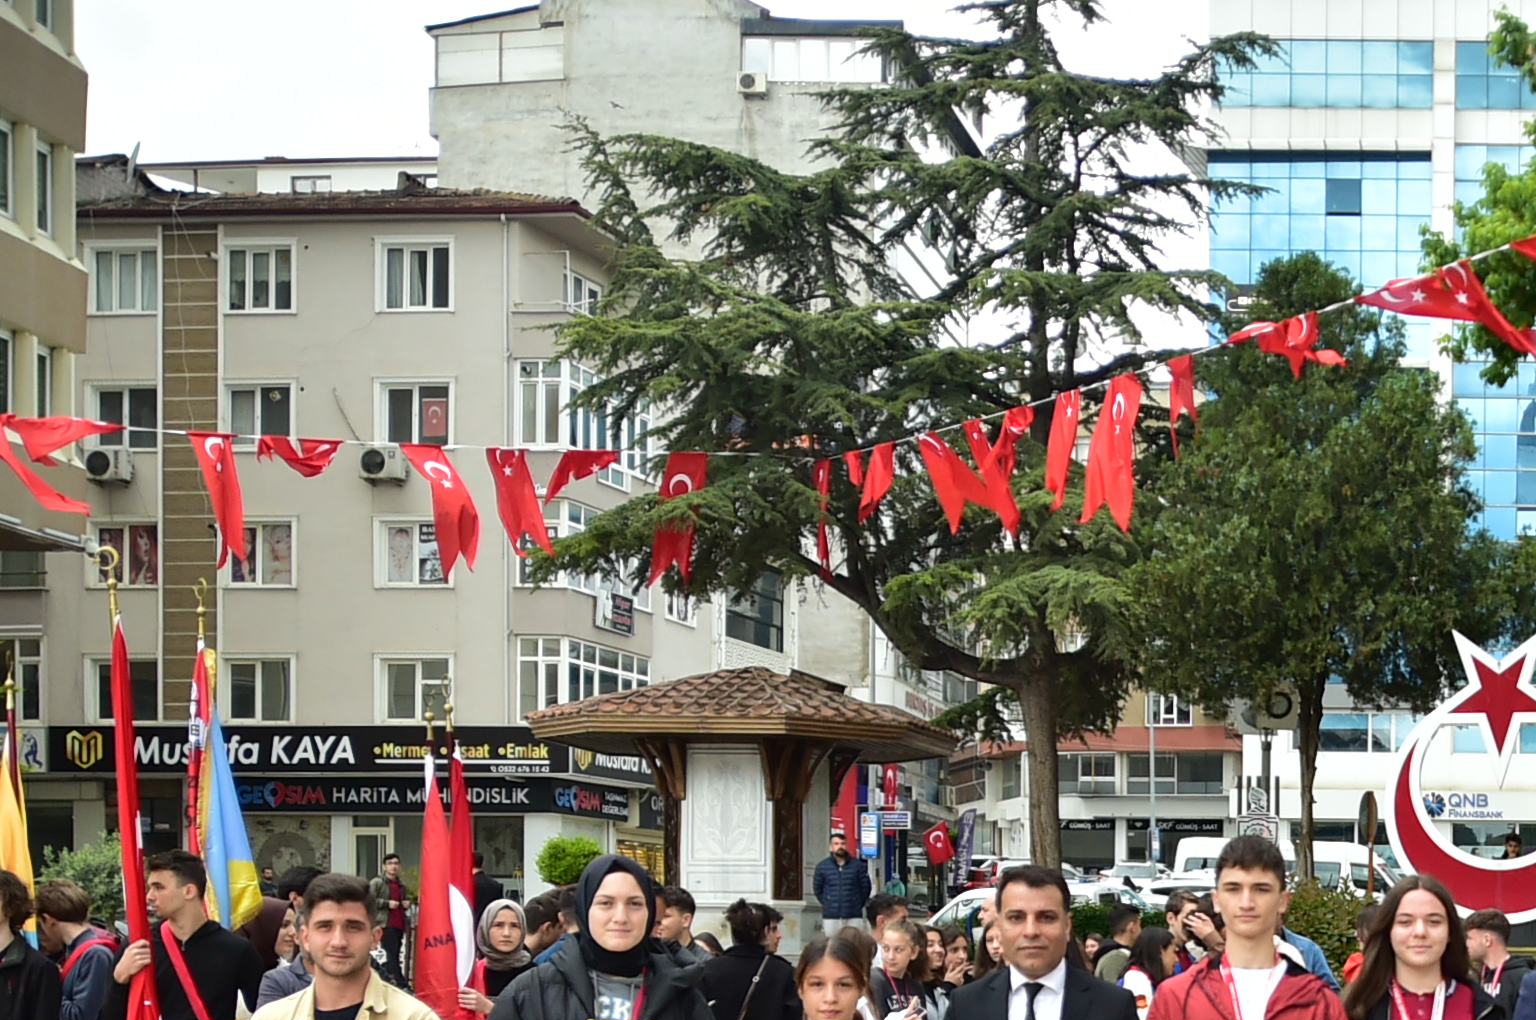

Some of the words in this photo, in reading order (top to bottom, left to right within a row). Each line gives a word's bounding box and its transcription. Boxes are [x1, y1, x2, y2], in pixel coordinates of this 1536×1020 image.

[134, 735, 259, 765] Musfa
[270, 735, 355, 765] KAYA
[382, 743, 433, 758] Merme
[506, 743, 549, 758] Emlak
[1448, 793, 1489, 808] QNB
